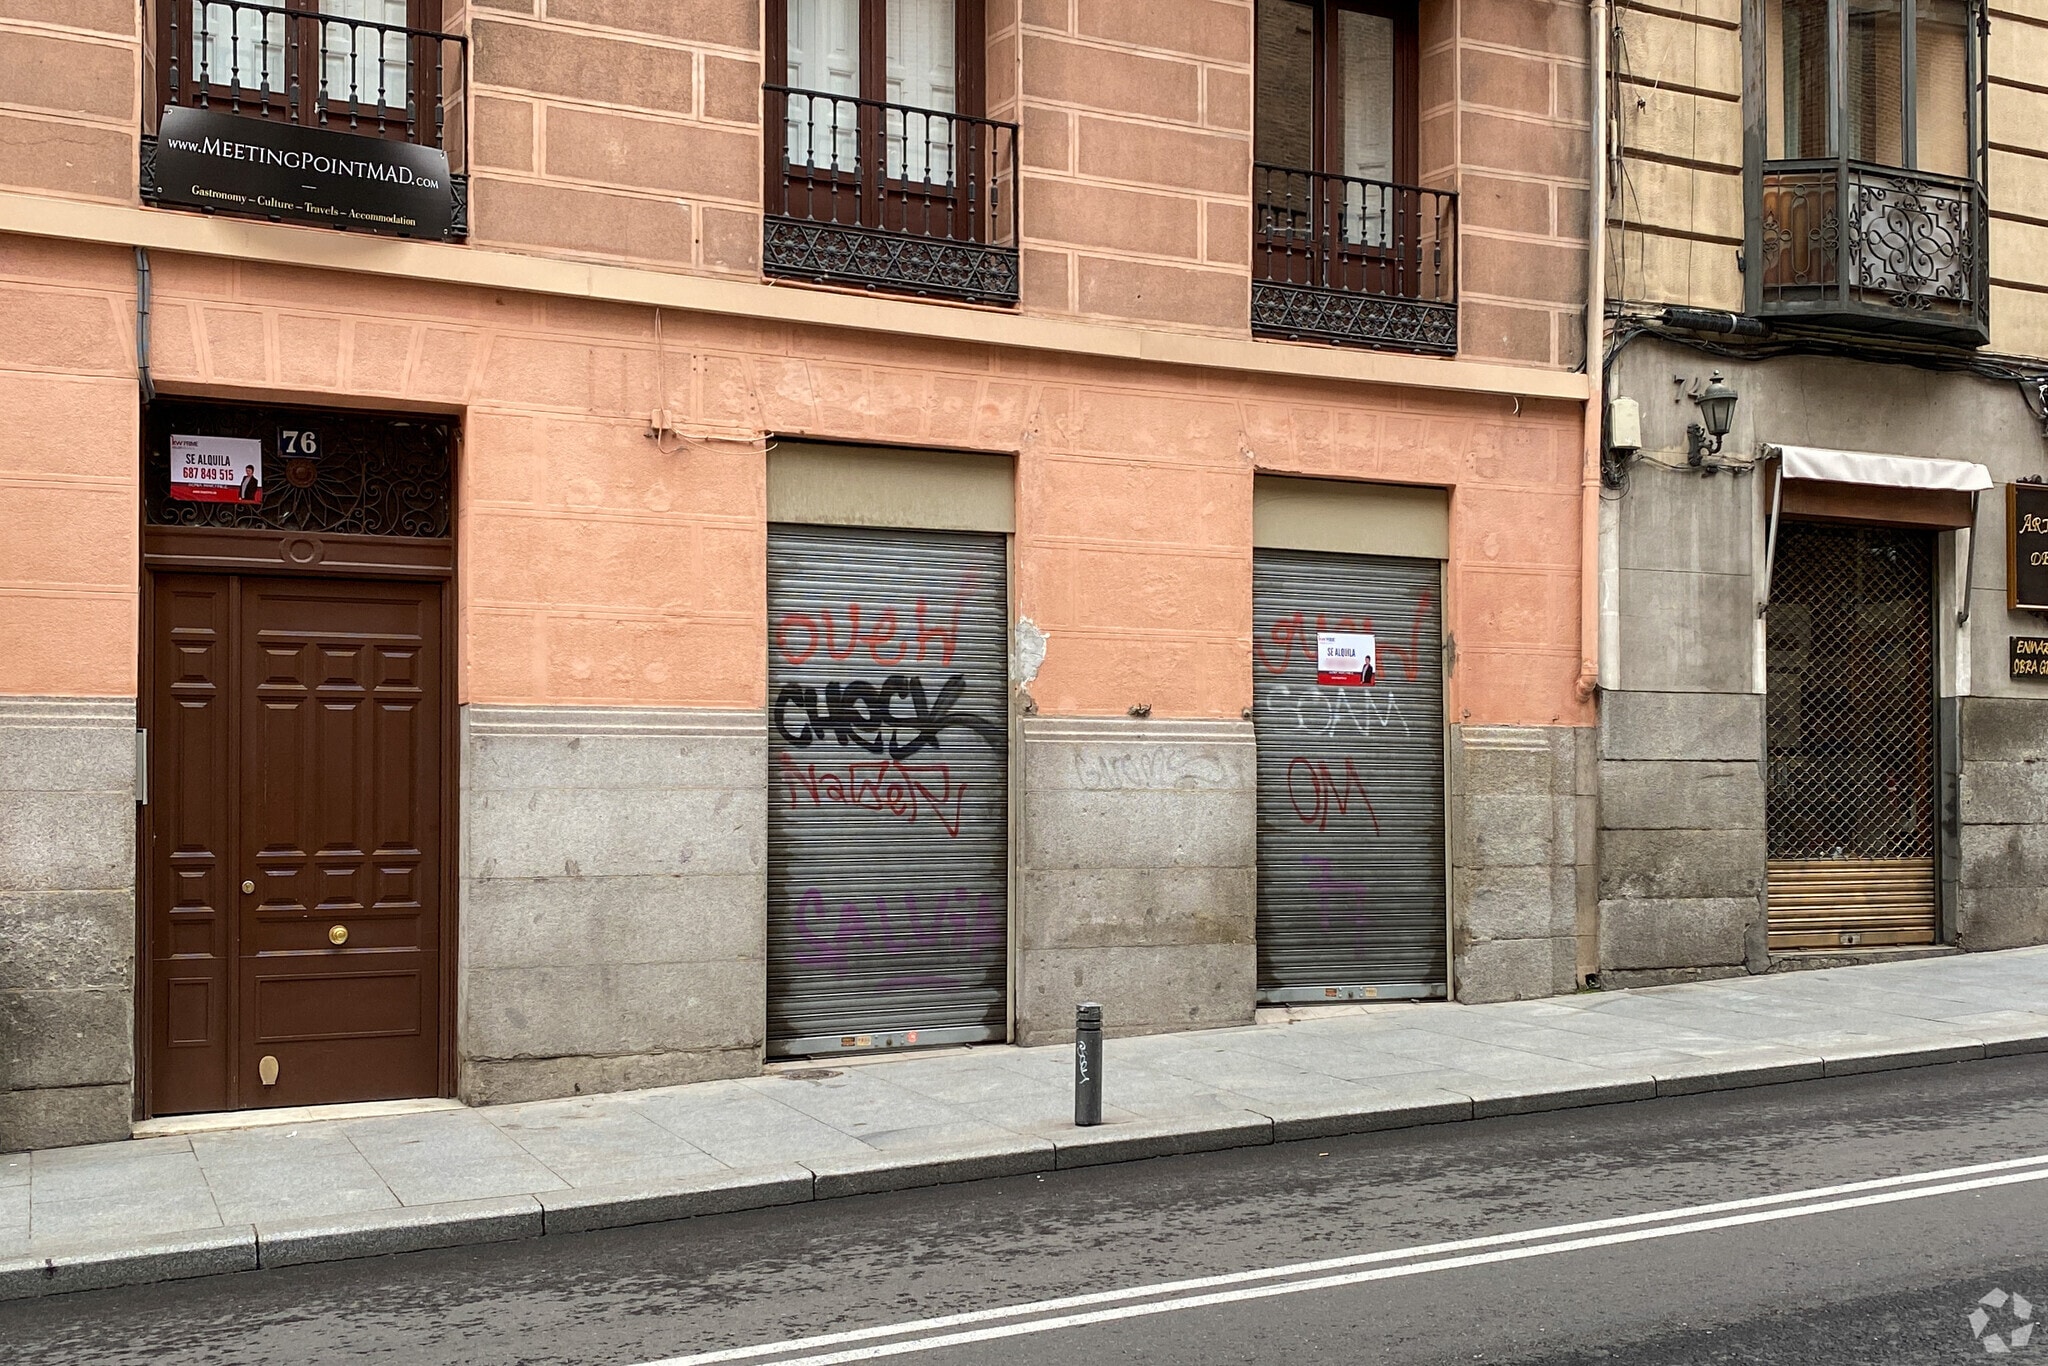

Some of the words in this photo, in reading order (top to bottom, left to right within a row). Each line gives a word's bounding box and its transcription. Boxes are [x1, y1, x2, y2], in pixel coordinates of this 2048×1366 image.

[191, 184, 247, 205] Gastronomy
[257, 195, 294, 210] Culture
[304, 202, 339, 217] Travels
[348, 208, 416, 227] Accommodation
[282, 430, 317, 454] 76
[185, 453, 196, 465] SE
[197, 455, 231, 467] ALQUILA
[183, 467, 198, 479] 687
[200, 468, 217, 480] 849
[219, 469, 234, 481] 515
[1327, 647, 1334, 657] SE
[1335, 647, 1356, 658] ALQUILA
[2012, 658, 2038, 675] OBRA
